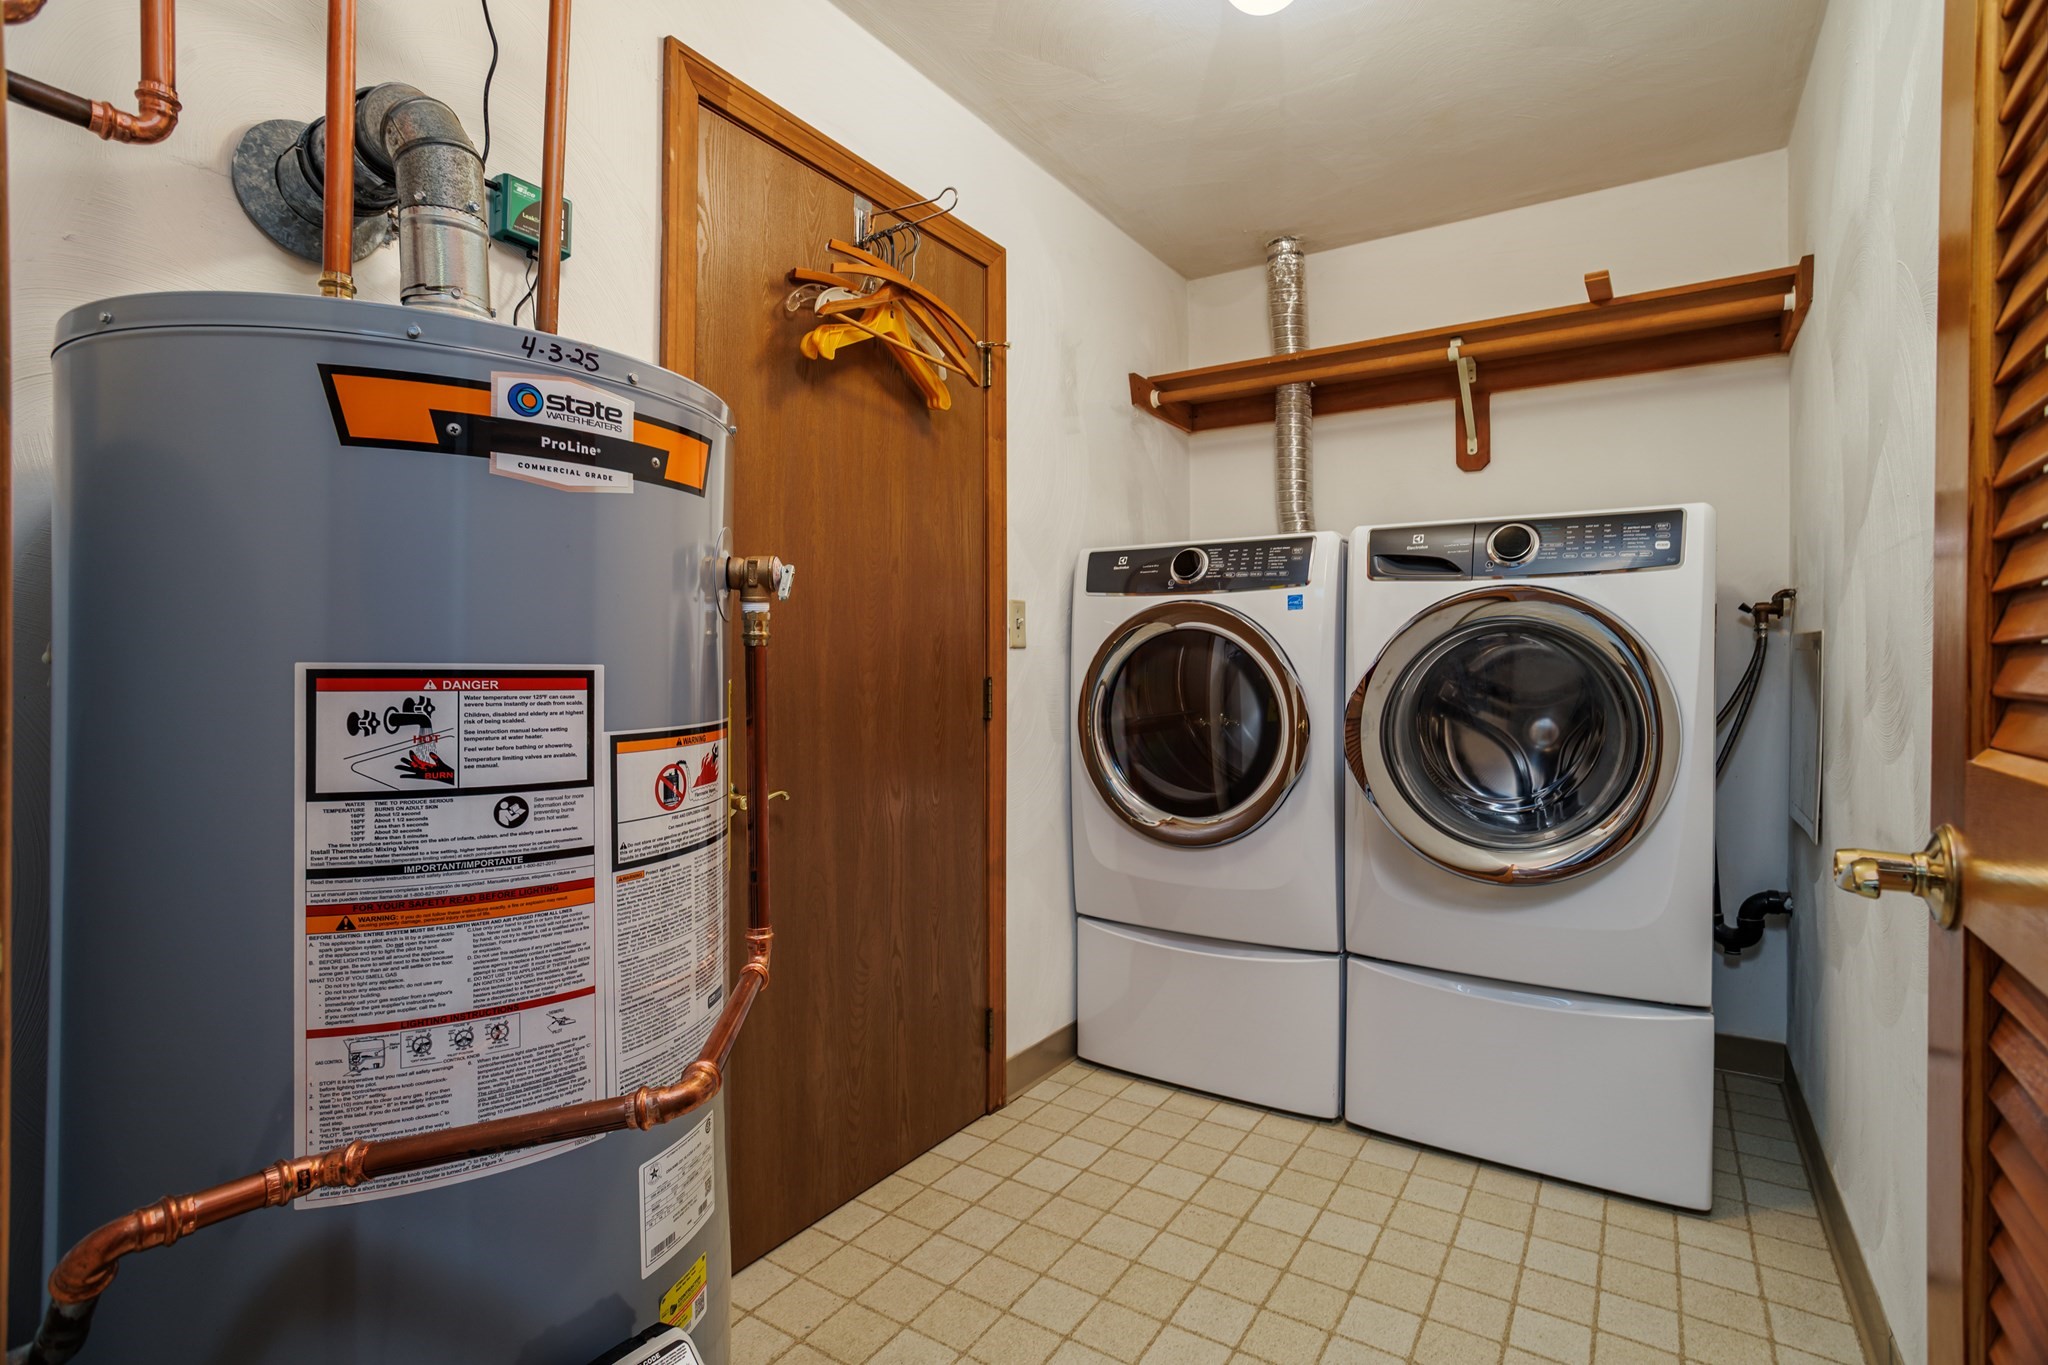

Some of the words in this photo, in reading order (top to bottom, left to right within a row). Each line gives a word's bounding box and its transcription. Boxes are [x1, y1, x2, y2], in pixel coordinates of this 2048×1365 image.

[522, 336, 600, 372] 4-3-25
[546, 394, 622, 424] state
[546, 411, 580, 424] WATER
[581, 416, 622, 432] HEATERS
[518, 462, 580, 476] COMMERCIAL
[585, 472, 613, 481] GRADE
[442, 680, 498, 690] DANGER
[414, 734, 440, 743] HOT
[682, 736, 706, 745] WARNING
[404, 856, 523, 874] IMPORTANT/IMPORTANTE
[353, 903, 374, 912] FOR
[376, 901, 405, 911] YOUR
[407, 898, 446, 908] SAFETY
[449, 894, 476, 906] READ
[478, 889, 515, 902] BEFORE
[518, 884, 558, 896] LIGHTING
[358, 914, 398, 923] WARNING:
[400, 1016, 447, 1029] LIGHTING
[450, 1003, 519, 1023] INSTRUCTIONS
